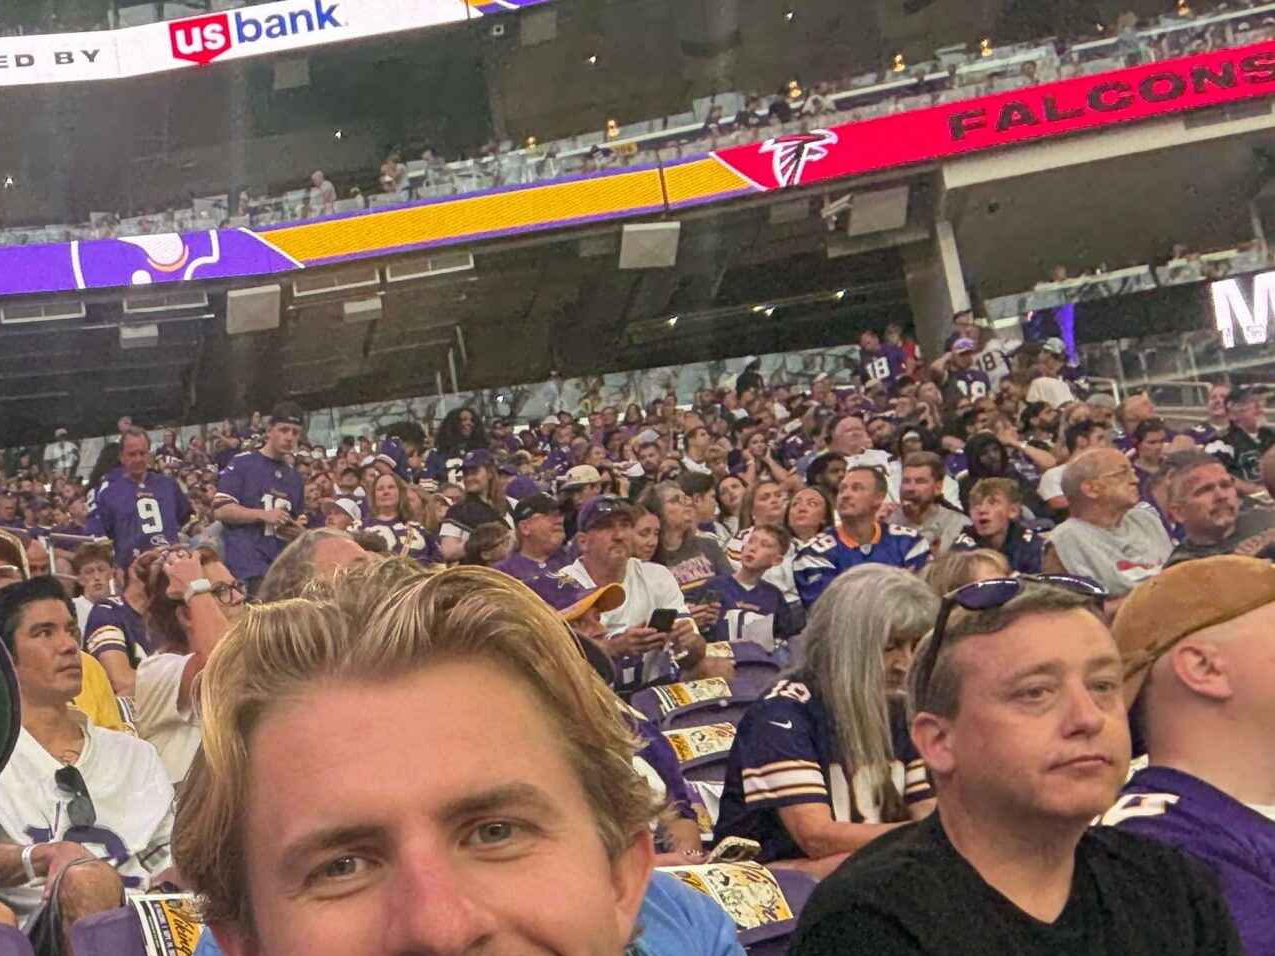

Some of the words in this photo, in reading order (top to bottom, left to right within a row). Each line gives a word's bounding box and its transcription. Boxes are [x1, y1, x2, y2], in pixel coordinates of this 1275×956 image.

[234, 0, 342, 44] bank
[54, 48, 102, 66] BY
[947, 52, 1275, 142] FALCONS
[136, 498, 163, 533] 9
